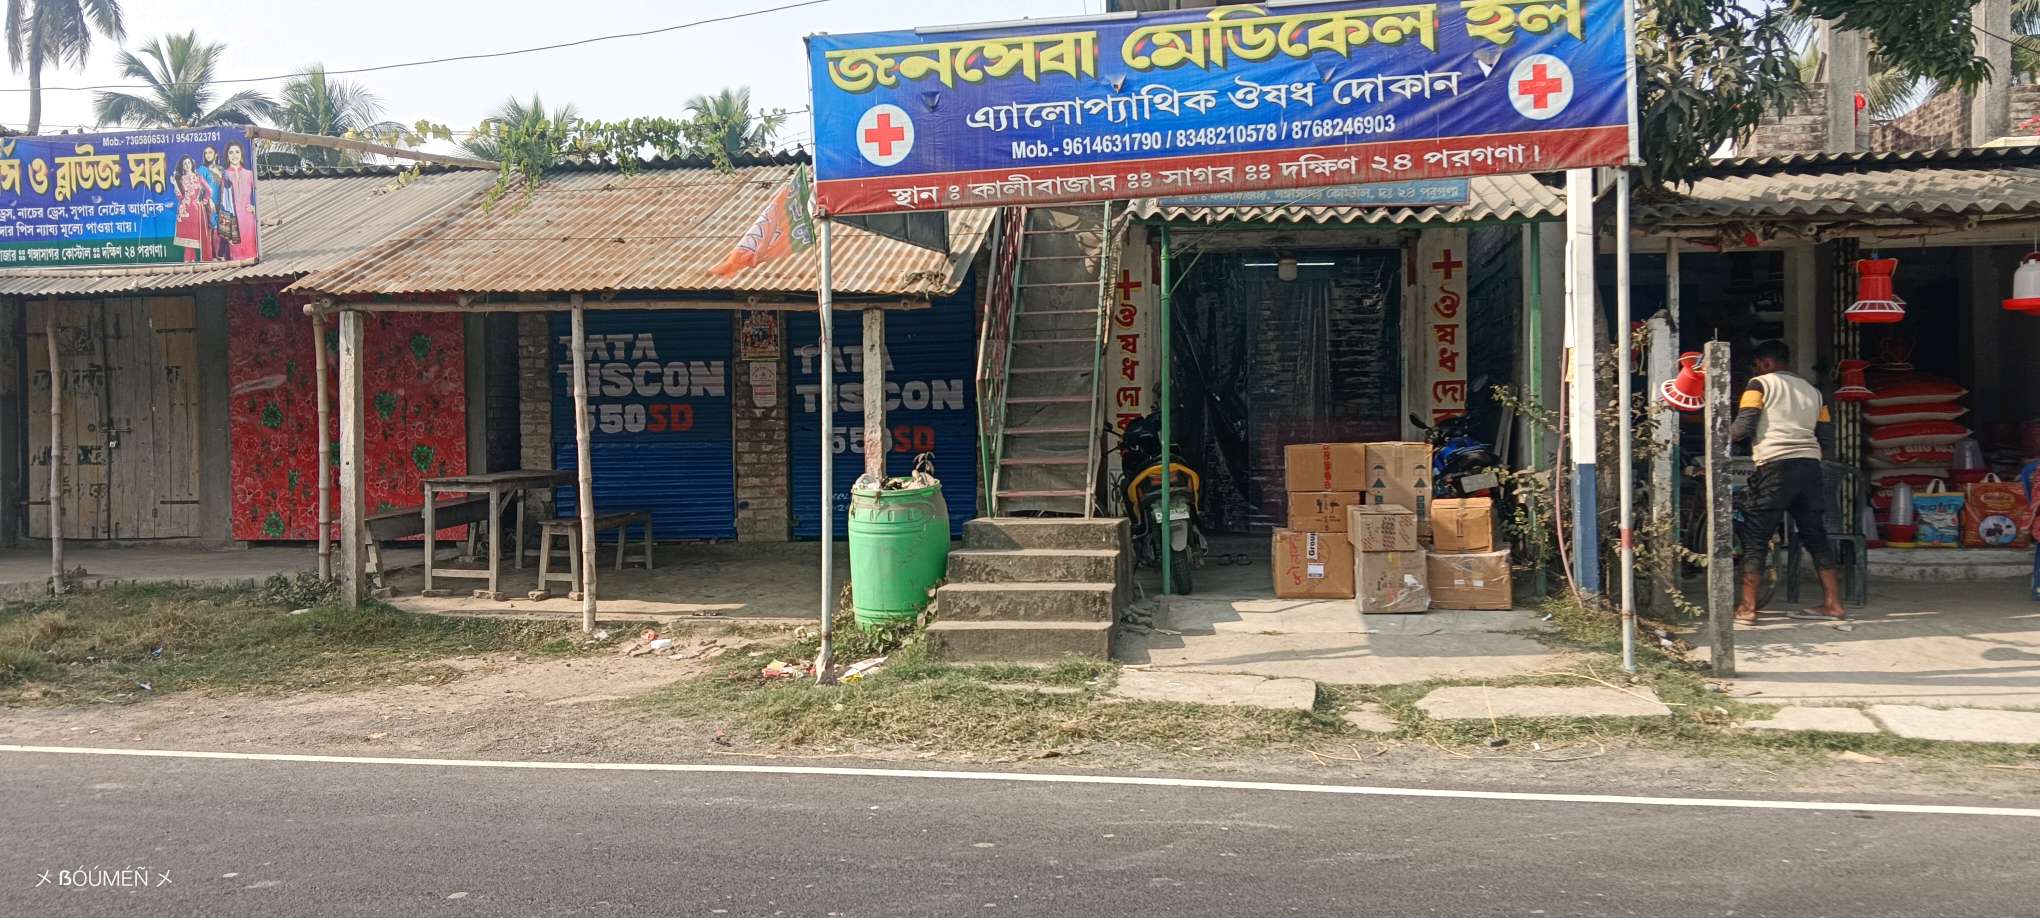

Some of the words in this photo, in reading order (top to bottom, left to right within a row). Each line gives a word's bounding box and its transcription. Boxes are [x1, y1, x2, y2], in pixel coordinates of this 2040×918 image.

[825, 31, 1097, 92] জনসেবা
[1121, 3, 1438, 69] মেডিকেল
[1460, 0, 1582, 44] হল
[1227, 75, 1317, 110] ঔষধ
[1333, 70, 1462, 106] দোকান
[1063, 132, 1161, 156] 9614631790
[1176, 123, 1278, 147] 8348210578
[1292, 114, 1395, 139] 8768246903
[28, 158, 48, 195] ও
[54, 143, 121, 201] ব্লাউজ
[127, 152, 166, 193] ঘর
[888, 184, 940, 209] স্থান
[968, 173, 1117, 199] কালীবাজার
[1158, 165, 1235, 187] সাগর
[1278, 154, 1358, 180] দক্ষিণ
[1370, 154, 1412, 174] ২৪
[98, 201, 126, 216] নেটের
[16, 221, 34, 237] পিস
[101, 241, 122, 260] দক্ষিণ
[124, 246, 136, 260] ২৪
[558, 333, 659, 361] TATA
[557, 361, 726, 397] TISCON
